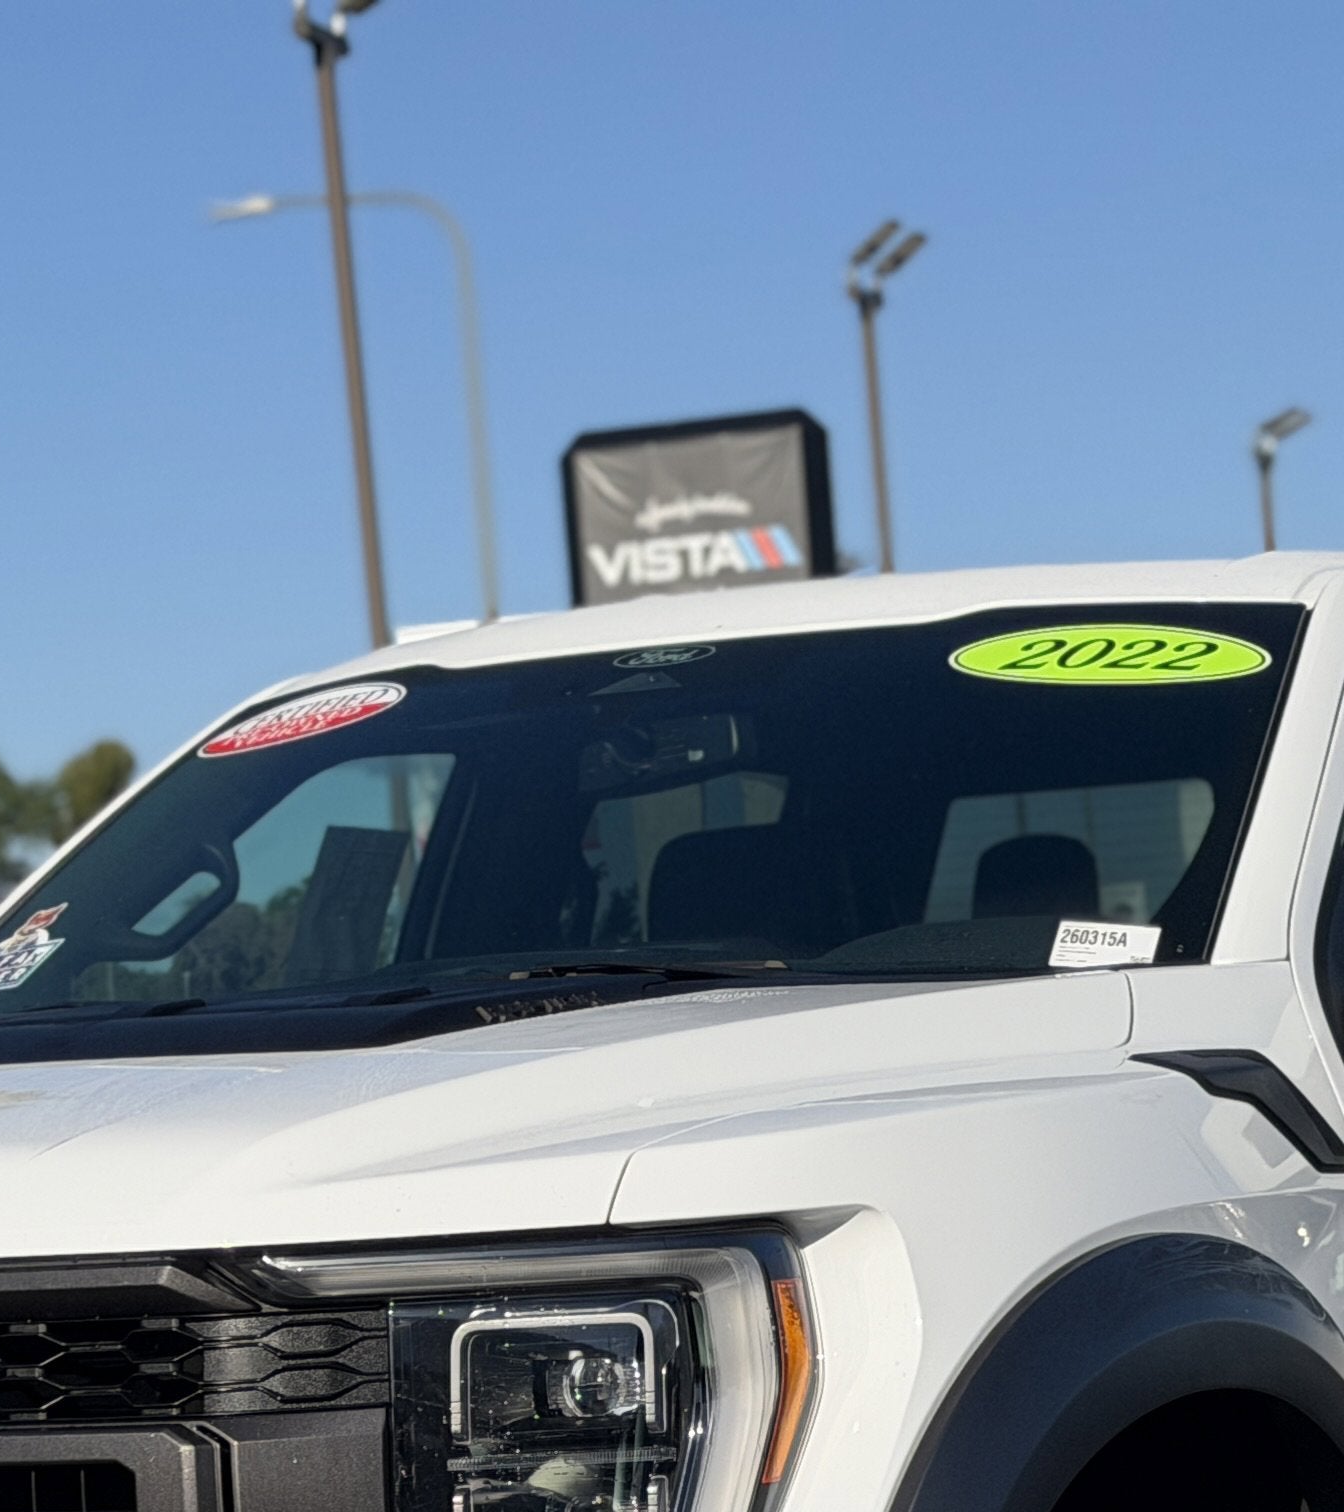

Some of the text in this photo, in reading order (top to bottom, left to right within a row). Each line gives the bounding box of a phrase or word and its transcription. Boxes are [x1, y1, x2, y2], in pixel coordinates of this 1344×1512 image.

[587, 530, 749, 588] VISTA
[628, 648, 700, 666] Ford
[997, 639, 1219, 672] 2022
[233, 687, 390, 737] CERTIFIED
[1059, 928, 1128, 948] 260315A
